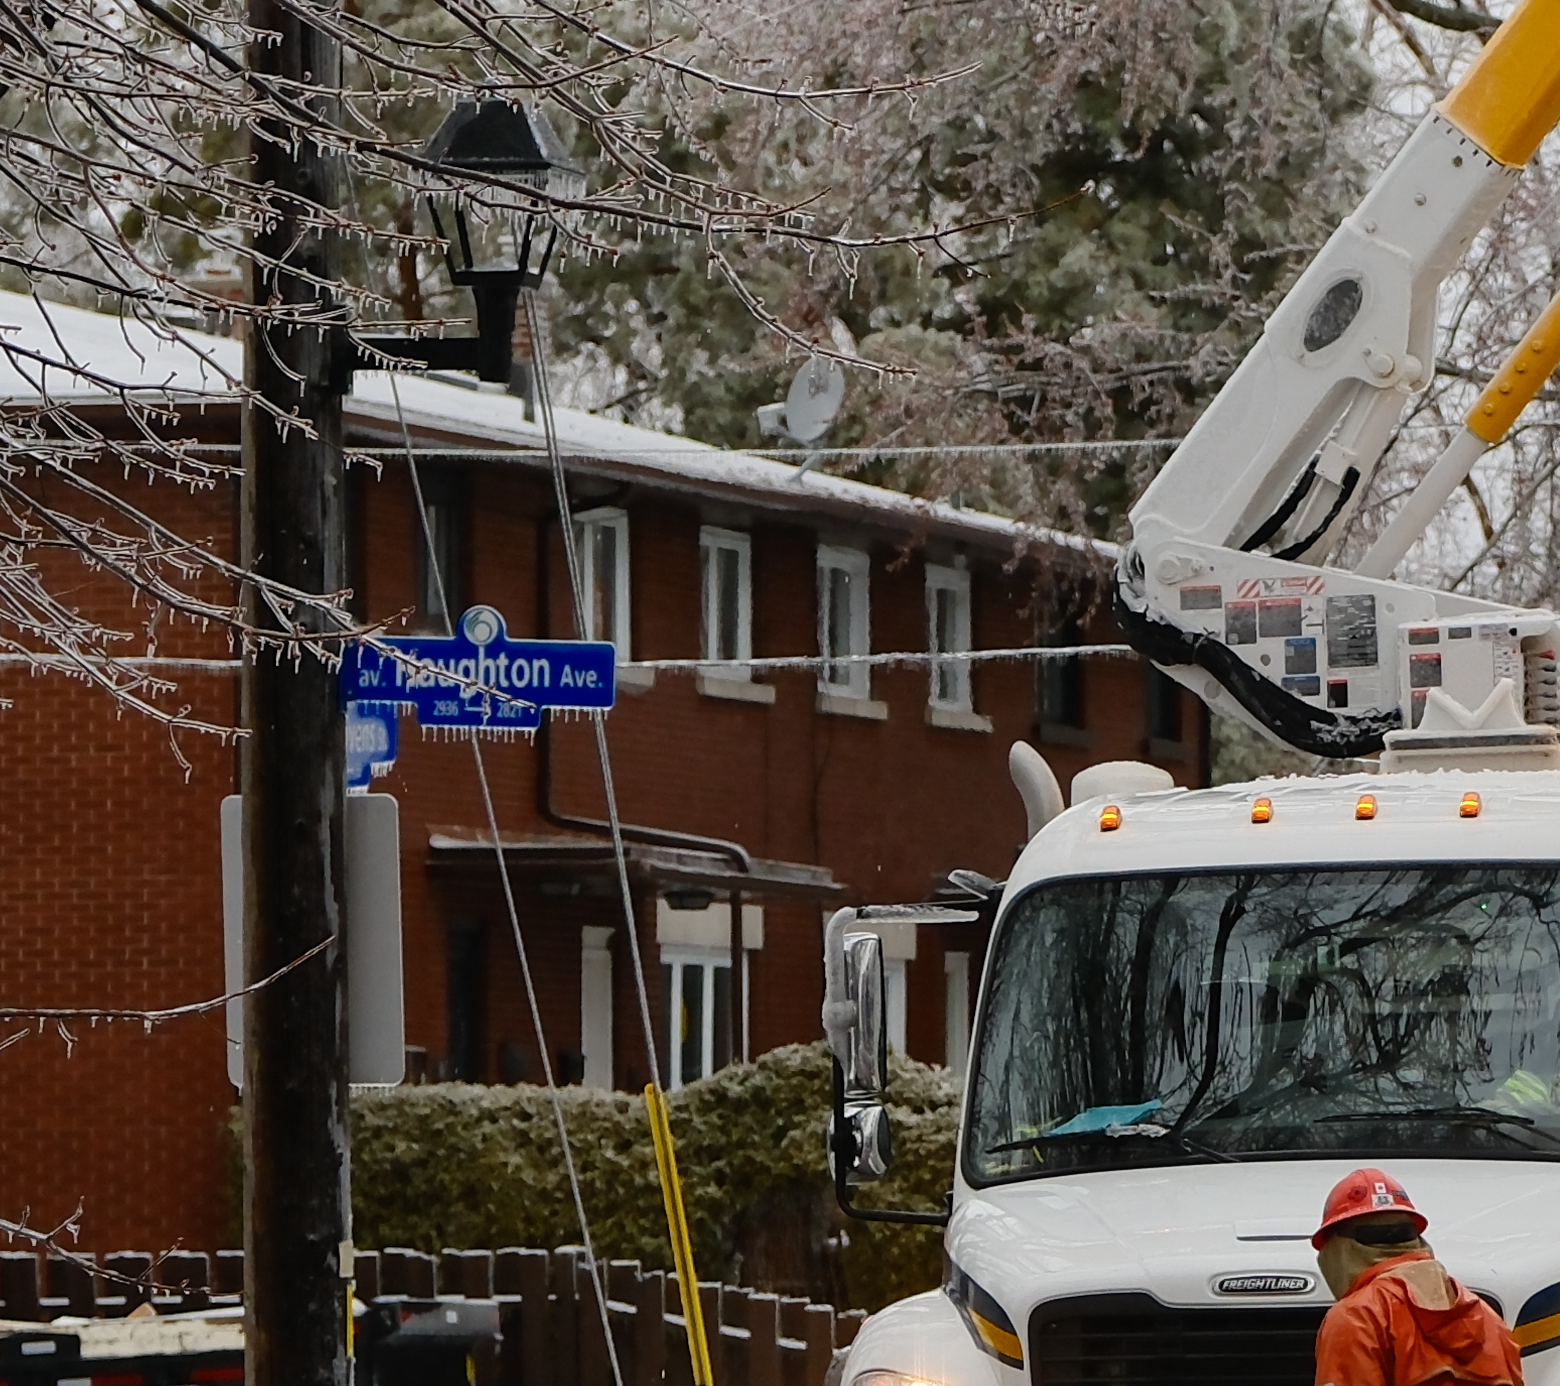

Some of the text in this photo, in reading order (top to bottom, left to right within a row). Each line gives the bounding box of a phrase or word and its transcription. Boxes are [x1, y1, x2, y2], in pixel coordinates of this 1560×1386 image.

[358, 651, 603, 700] av. Haughton Ave.
[433, 699, 459, 717] 2936
[1222, 1278, 1305, 1290] FREIGHTLINER
